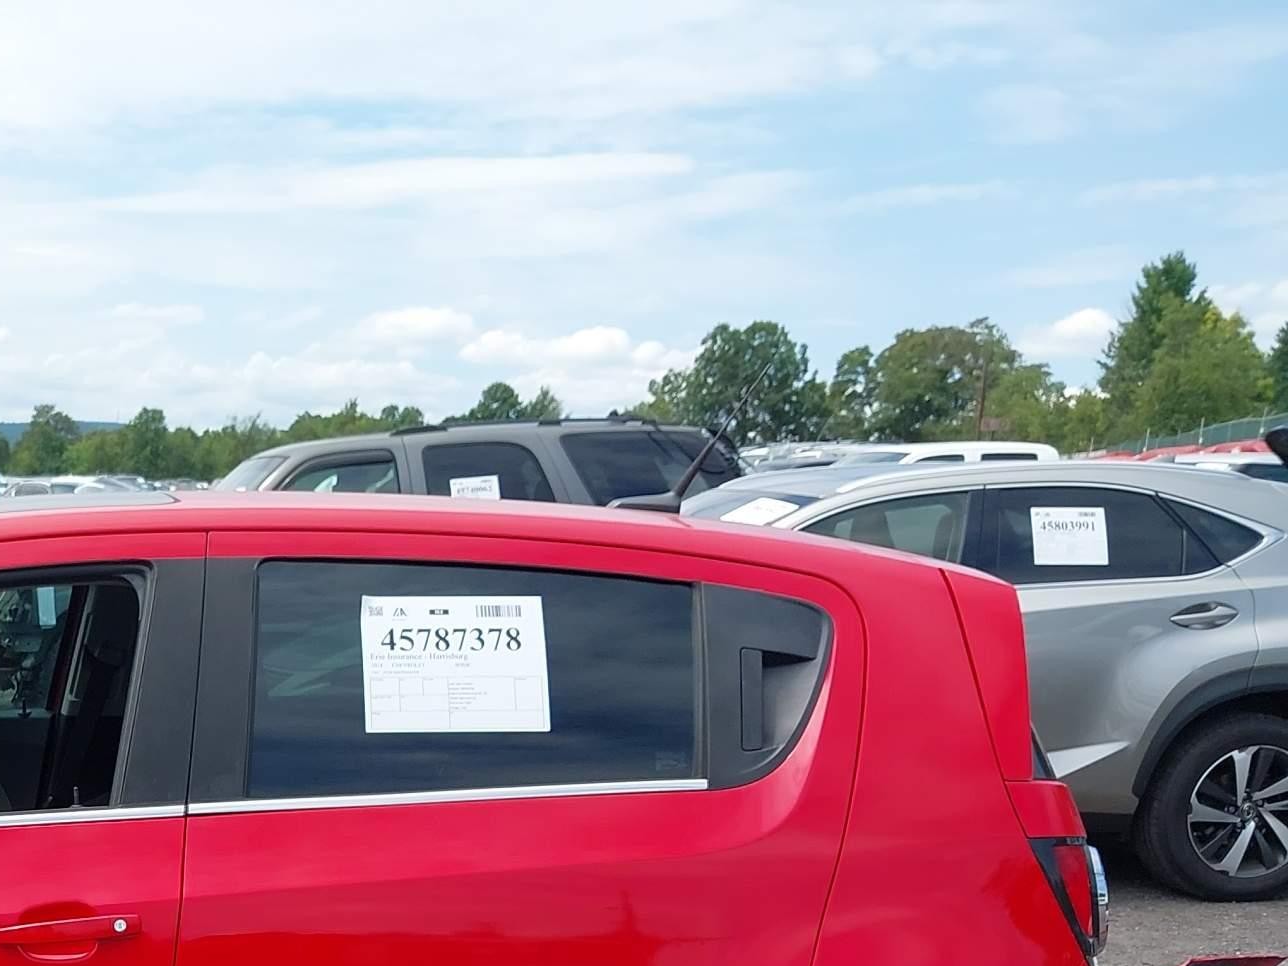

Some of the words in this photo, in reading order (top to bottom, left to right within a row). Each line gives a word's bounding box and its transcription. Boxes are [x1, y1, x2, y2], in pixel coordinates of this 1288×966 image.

[1040, 520, 1096, 531] 45803991
[380, 627, 522, 652] 45787378
[429, 653, 469, 661] Harrisburg
